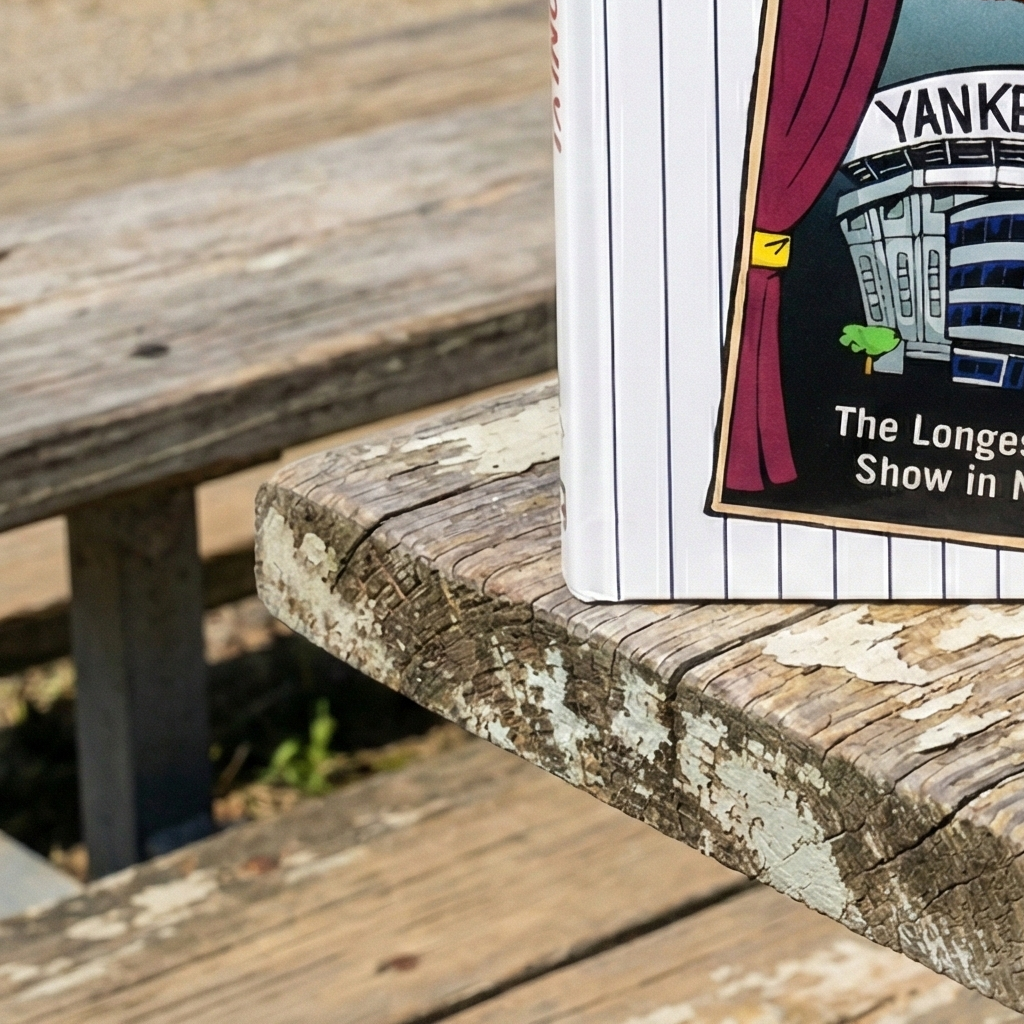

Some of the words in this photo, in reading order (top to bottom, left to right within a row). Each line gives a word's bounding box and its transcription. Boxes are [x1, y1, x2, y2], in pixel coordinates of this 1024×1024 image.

[834, 404, 899, 443] The
[855, 453, 953, 493] Show
[966, 463, 997, 499] in
